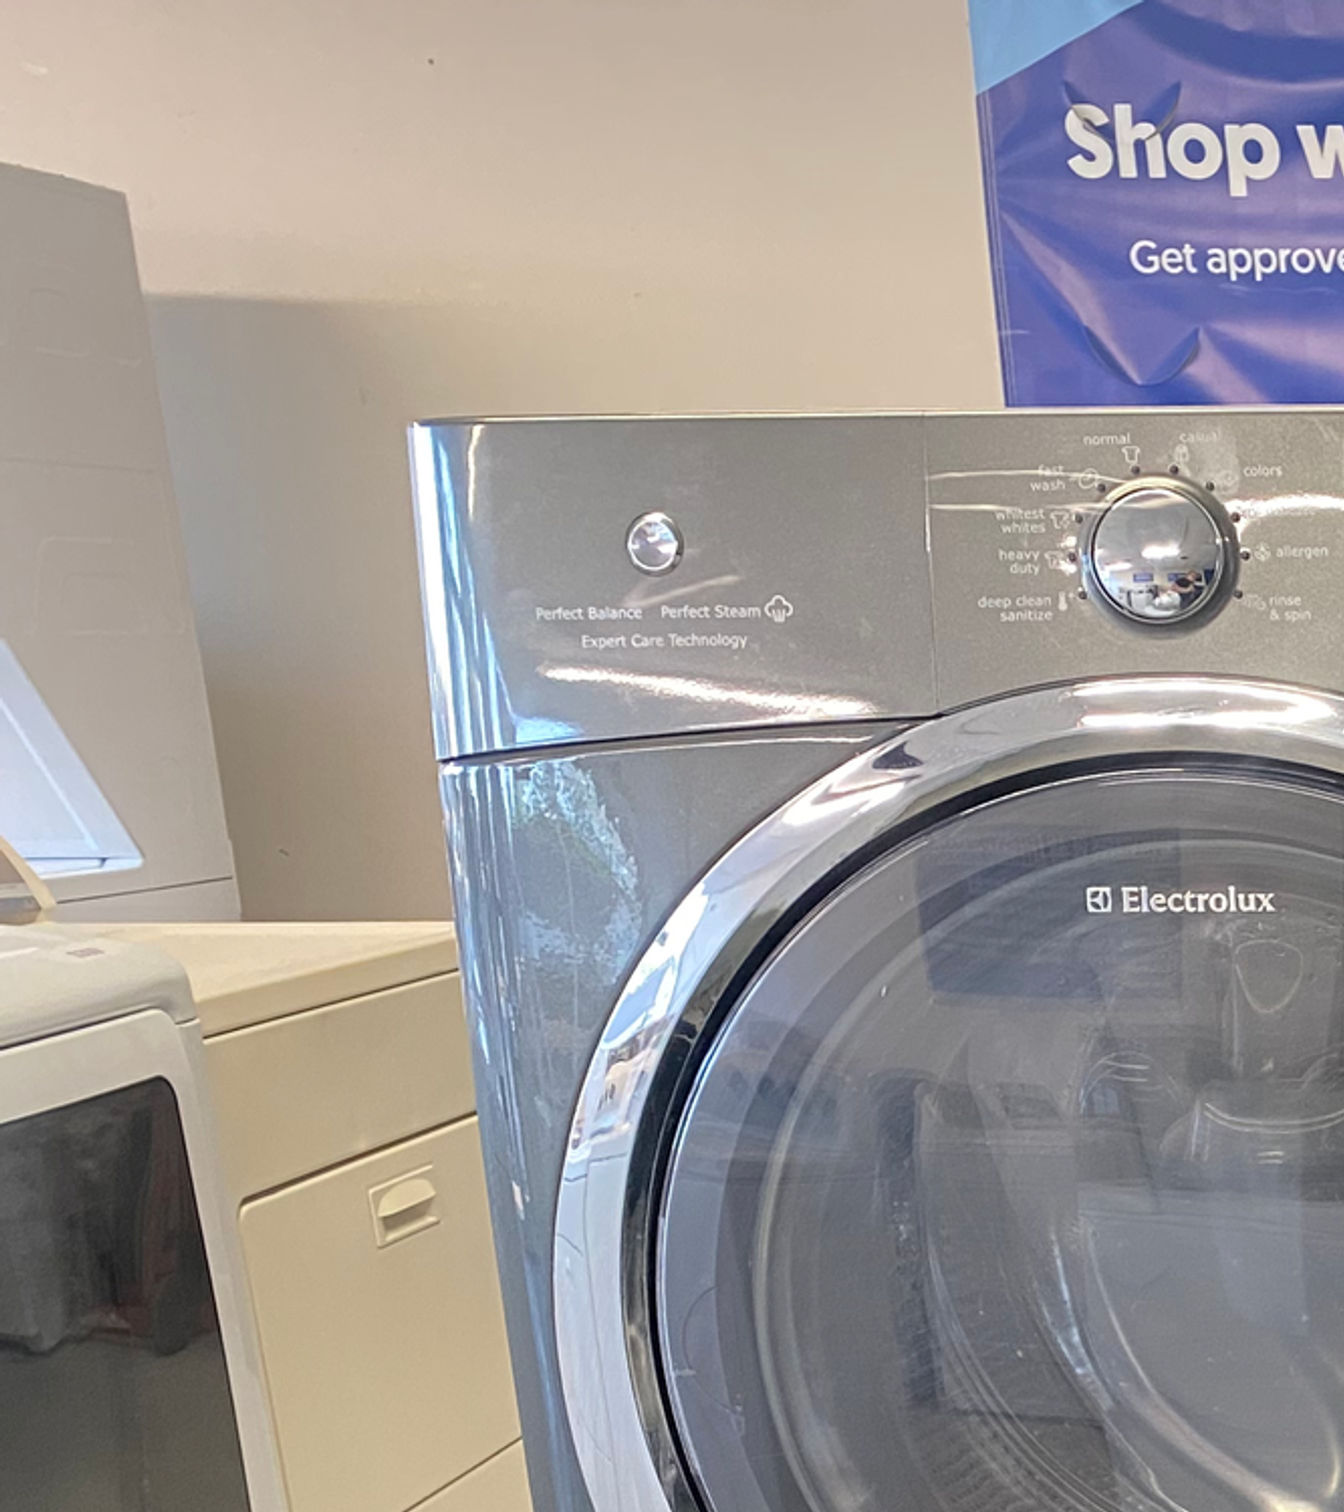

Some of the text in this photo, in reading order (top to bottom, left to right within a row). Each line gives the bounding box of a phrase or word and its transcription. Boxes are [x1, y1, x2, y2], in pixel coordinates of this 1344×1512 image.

[1064, 103, 1281, 197] Shop
[1129, 240, 1198, 274] Get
[1083, 432, 1131, 446] normal
[1038, 465, 1064, 478] fast
[1243, 463, 1283, 478] colors
[1029, 479, 1066, 491] wash
[995, 507, 1046, 520] whitest
[1001, 521, 1047, 534] whites
[998, 548, 1041, 564] heavy
[1275, 545, 1330, 562] allergen
[1010, 561, 1041, 576] duty
[977, 594, 1053, 610] deep clean
[1269, 595, 1302, 608] rinse
[536, 606, 643, 620] Perfect Balance
[661, 605, 762, 620] Perfect Steam
[1000, 608, 1054, 623] sanitize
[1270, 608, 1312, 623] & spin
[581, 634, 748, 650] Expert Care Technology
[1121, 885, 1276, 913] Electrolux
